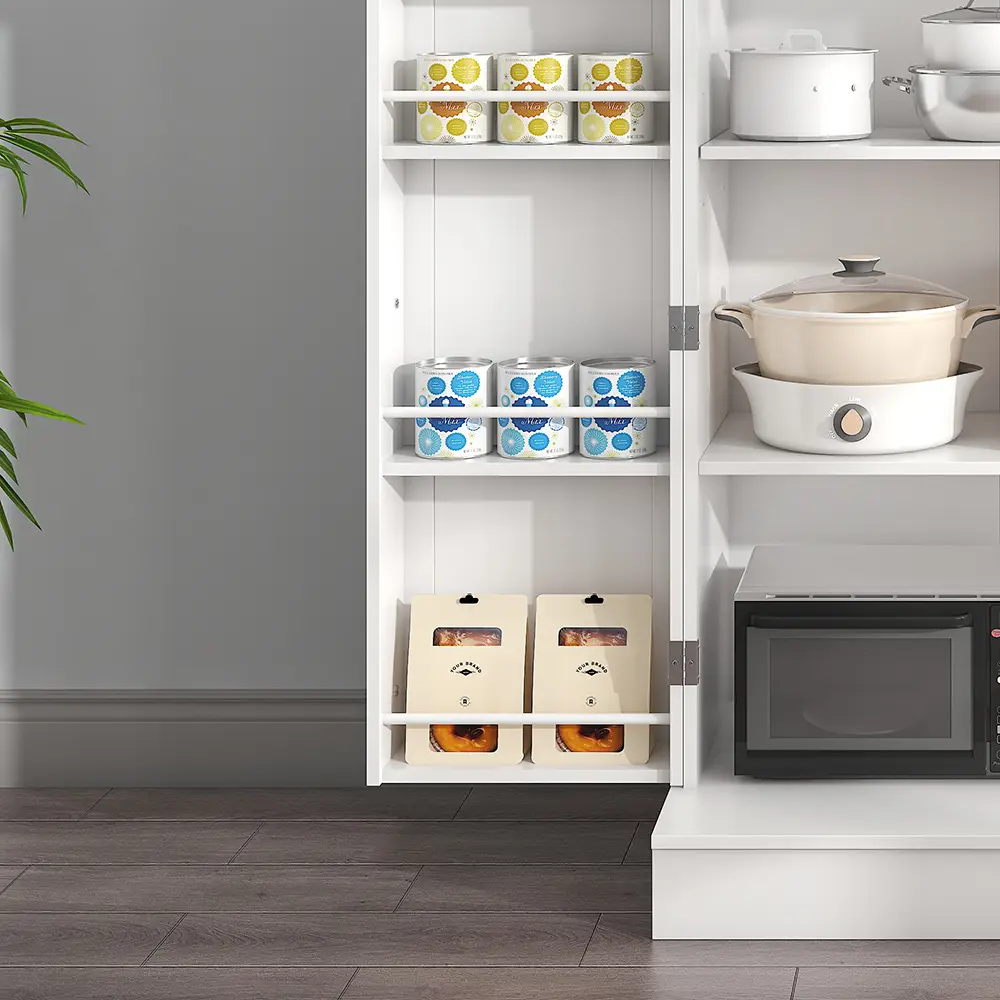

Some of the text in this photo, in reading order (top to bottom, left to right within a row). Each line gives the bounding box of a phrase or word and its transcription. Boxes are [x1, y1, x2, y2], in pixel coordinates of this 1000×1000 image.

[450, 661, 482, 674] YOUR BRAND
[576, 661, 608, 674] YOUR BRAND
